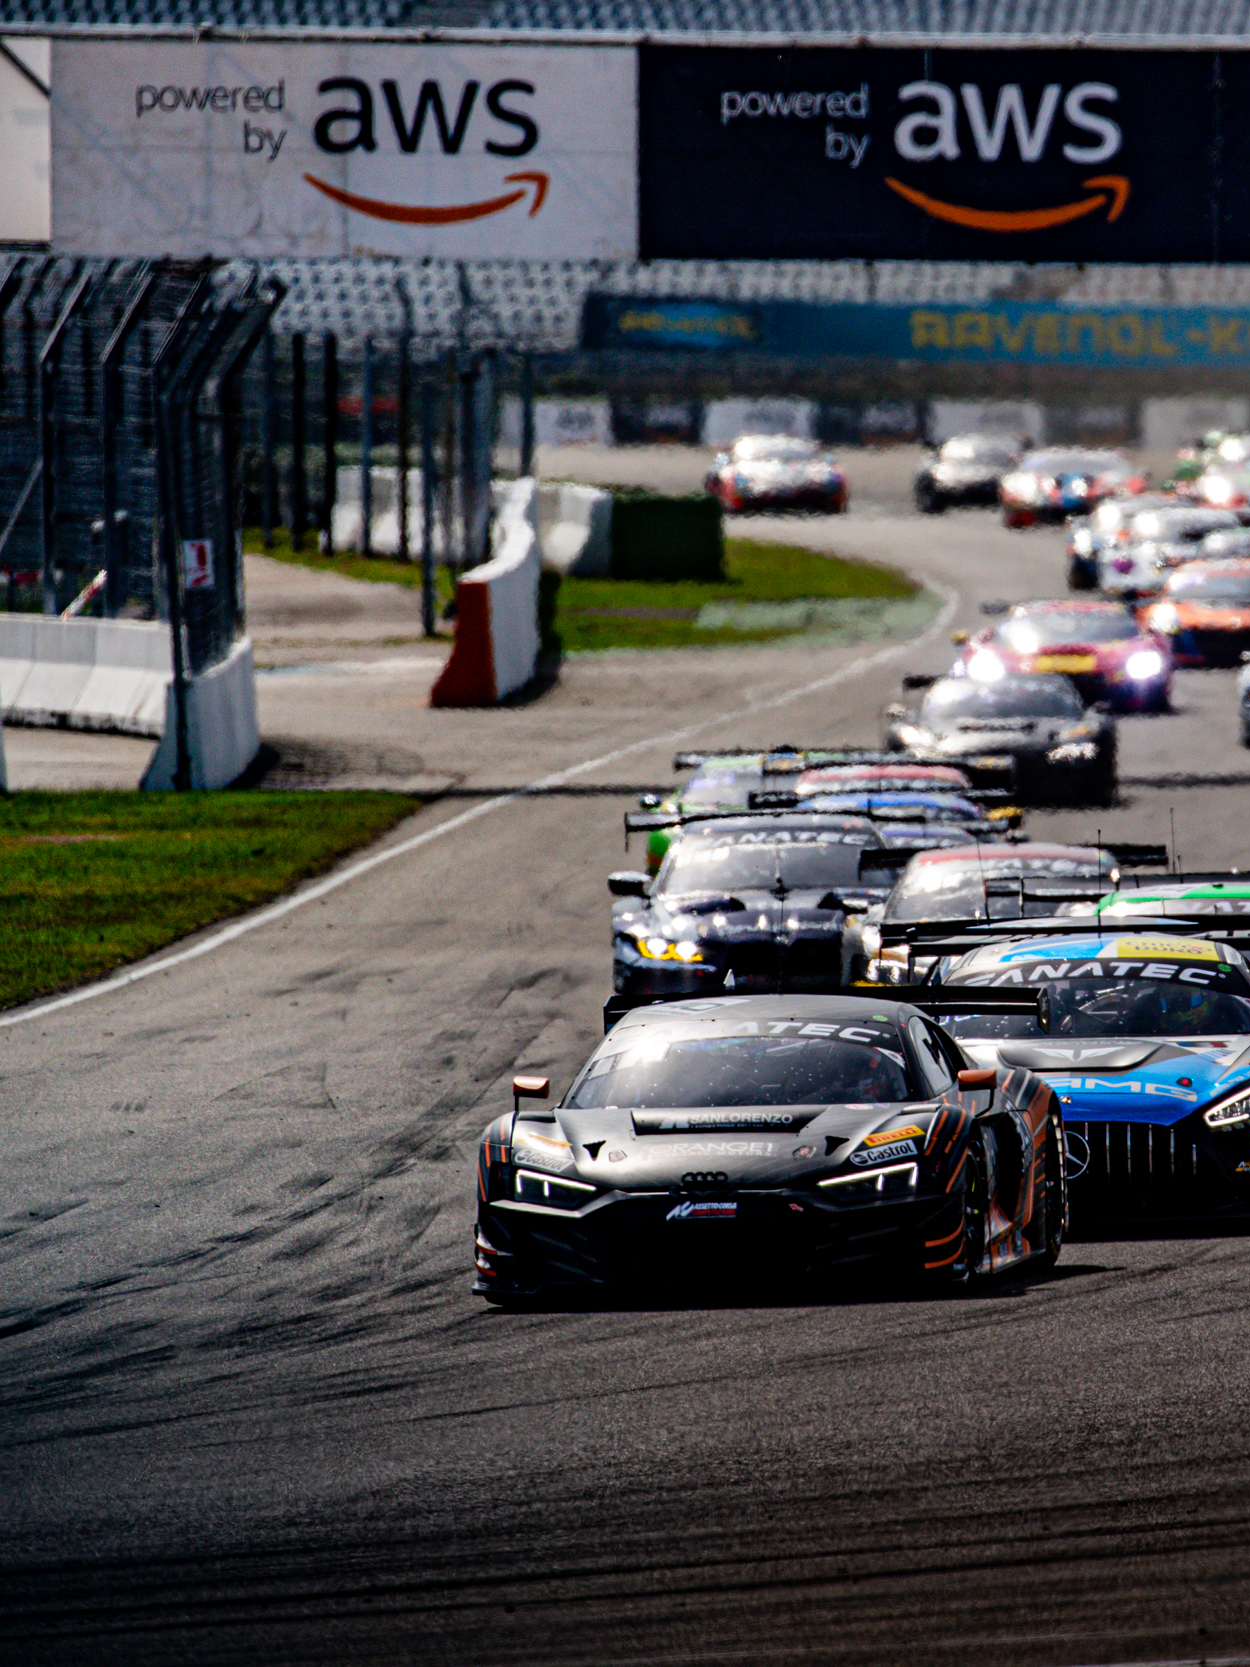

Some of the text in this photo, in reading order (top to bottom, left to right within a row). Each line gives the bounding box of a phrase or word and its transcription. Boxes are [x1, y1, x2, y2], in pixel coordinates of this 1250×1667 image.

[135, 79, 285, 117] powered
[313, 75, 540, 157] aws
[721, 84, 869, 122] powered
[243, 119, 288, 161] by
[893, 81, 1122, 164] aws
[825, 124, 870, 167] by
[965, 960, 1218, 987] FANATEC
[689, 1112, 793, 1125] SANLORENZO
[526, 1152, 568, 1171] Castrol
[649, 1142, 774, 1155] ORANGE1
[867, 1142, 915, 1162] Castrol
